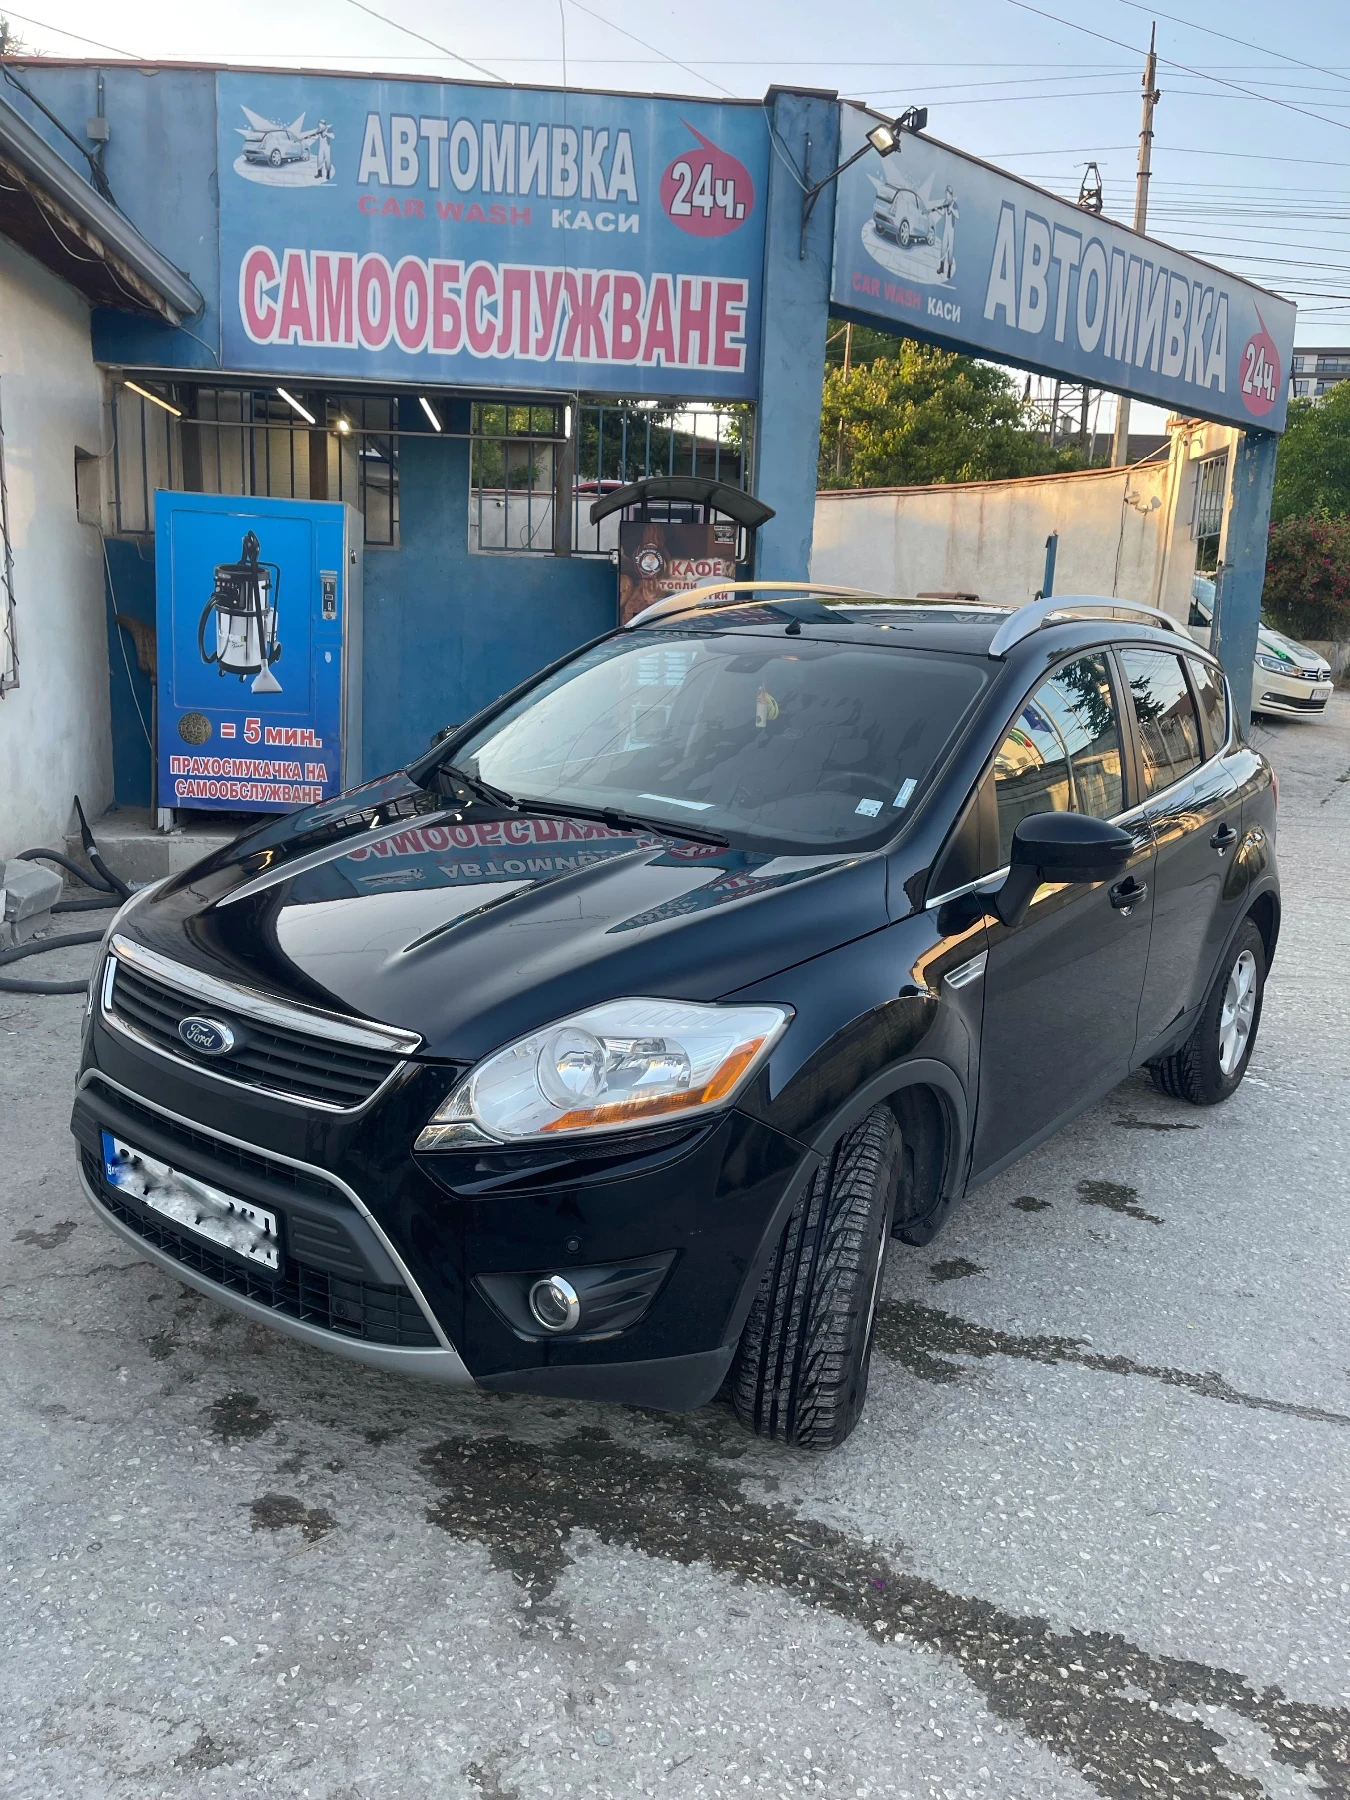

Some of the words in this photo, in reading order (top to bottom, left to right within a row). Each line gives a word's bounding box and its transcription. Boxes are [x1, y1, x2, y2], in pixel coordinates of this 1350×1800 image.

[357, 111, 639, 204] АВТОМИВКА
[669, 161, 746, 221] 24ч.
[357, 195, 425, 218] CAR
[436, 201, 532, 226] WASH
[551, 208, 639, 233] КАСИ
[852, 271, 880, 298] CAR
[883, 281, 922, 310] WASH
[983, 199, 1229, 394] АВТОМИВКА
[239, 245, 748, 372] САМООБСЛУЖВАНЕ
[927, 296, 961, 323] КАСИ
[1242, 341, 1276, 402] 24ч.
[243, 717, 262, 744] 5
[170, 755, 302, 780] ПРАХОСМУКАЧКА
[304, 763, 328, 782] НА
[175, 779, 322, 804] САМООБСЛУЖВАНЕ
[186, 1023, 215, 1047] Ford
